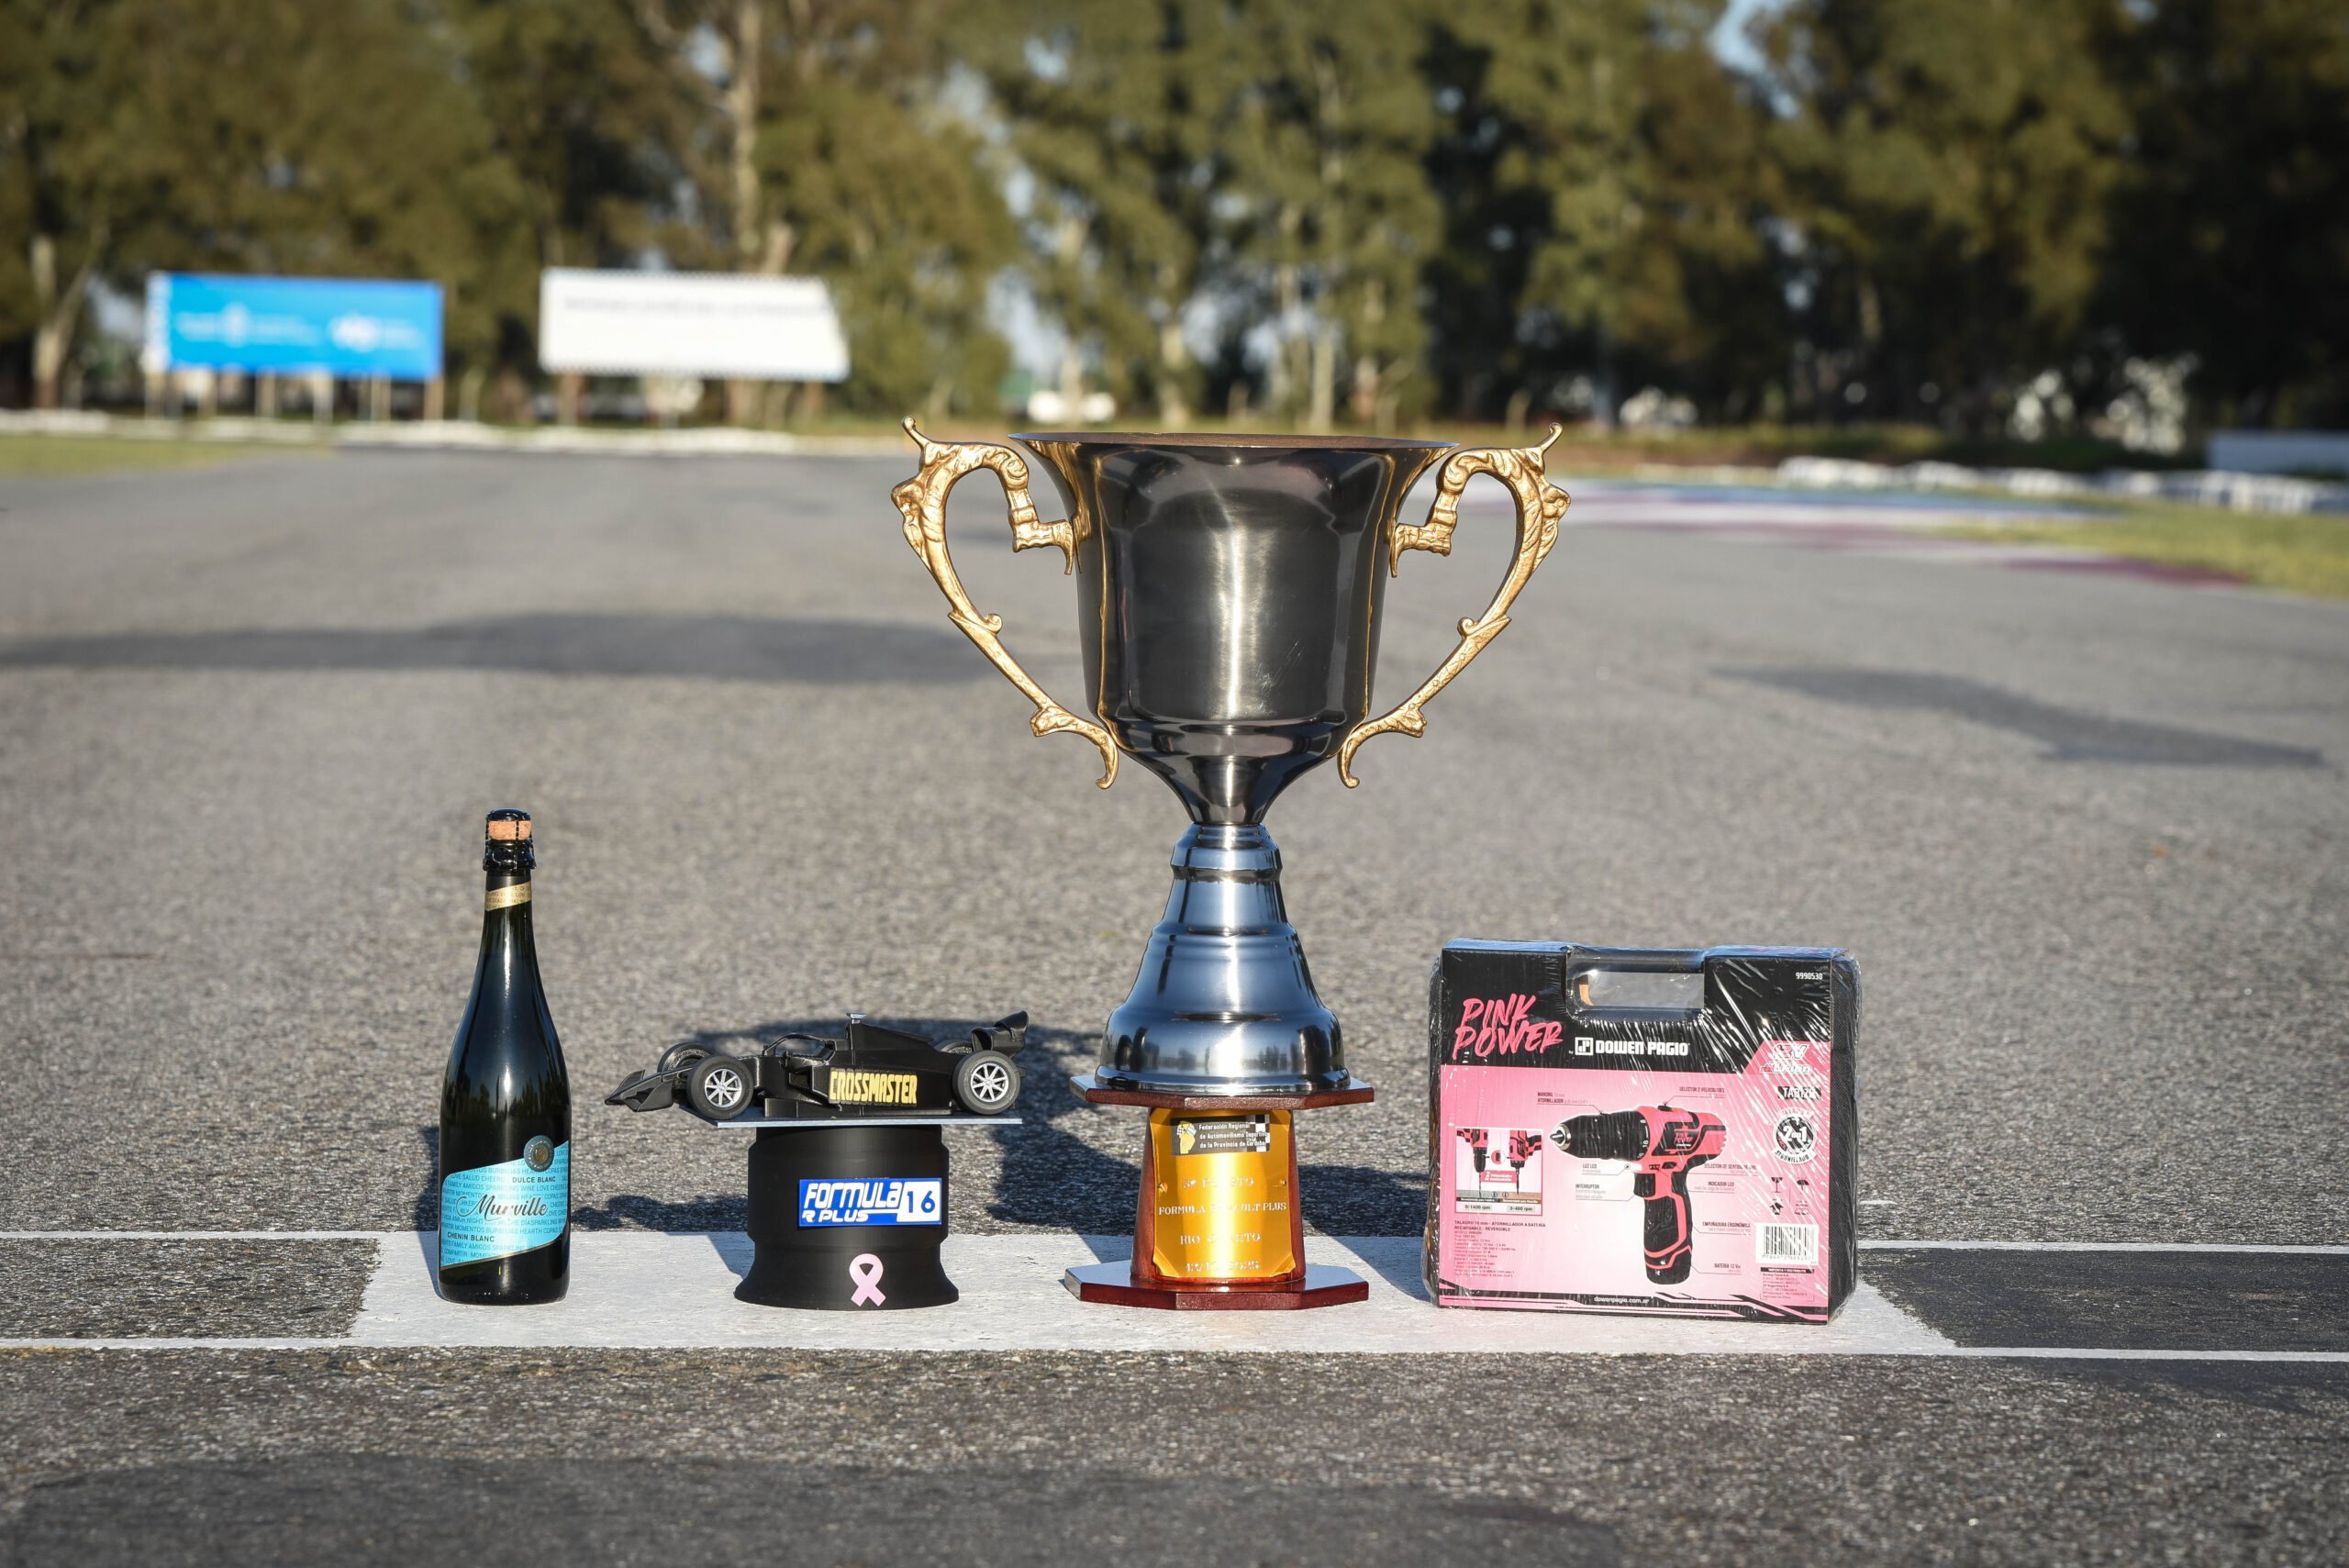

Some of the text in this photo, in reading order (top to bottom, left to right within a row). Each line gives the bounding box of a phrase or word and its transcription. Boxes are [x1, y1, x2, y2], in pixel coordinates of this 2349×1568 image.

[1460, 993, 1536, 1029] PINK
[1453, 1020, 1564, 1060] POWER
[1596, 1040, 1688, 1056] DOWEN PAGIO
[829, 1071, 918, 1104] CROSSMASTER
[1229, 1122, 1250, 1130] Regional
[456, 1194, 548, 1222] Murville
[907, 1190, 935, 1213] 16
[1159, 1206, 1206, 1215] FORMULA
[1263, 1202, 1286, 1211] PLUS
[802, 1209, 869, 1222] R PLUS
[454, 1224, 484, 1232] MOMENTOS
[447, 1231, 495, 1242] CHENIN BLANC
[1180, 1235, 1200, 1245] RIO
[444, 1248, 468, 1257] COMPARTIR
[469, 1242, 491, 1251] AMIGOS
